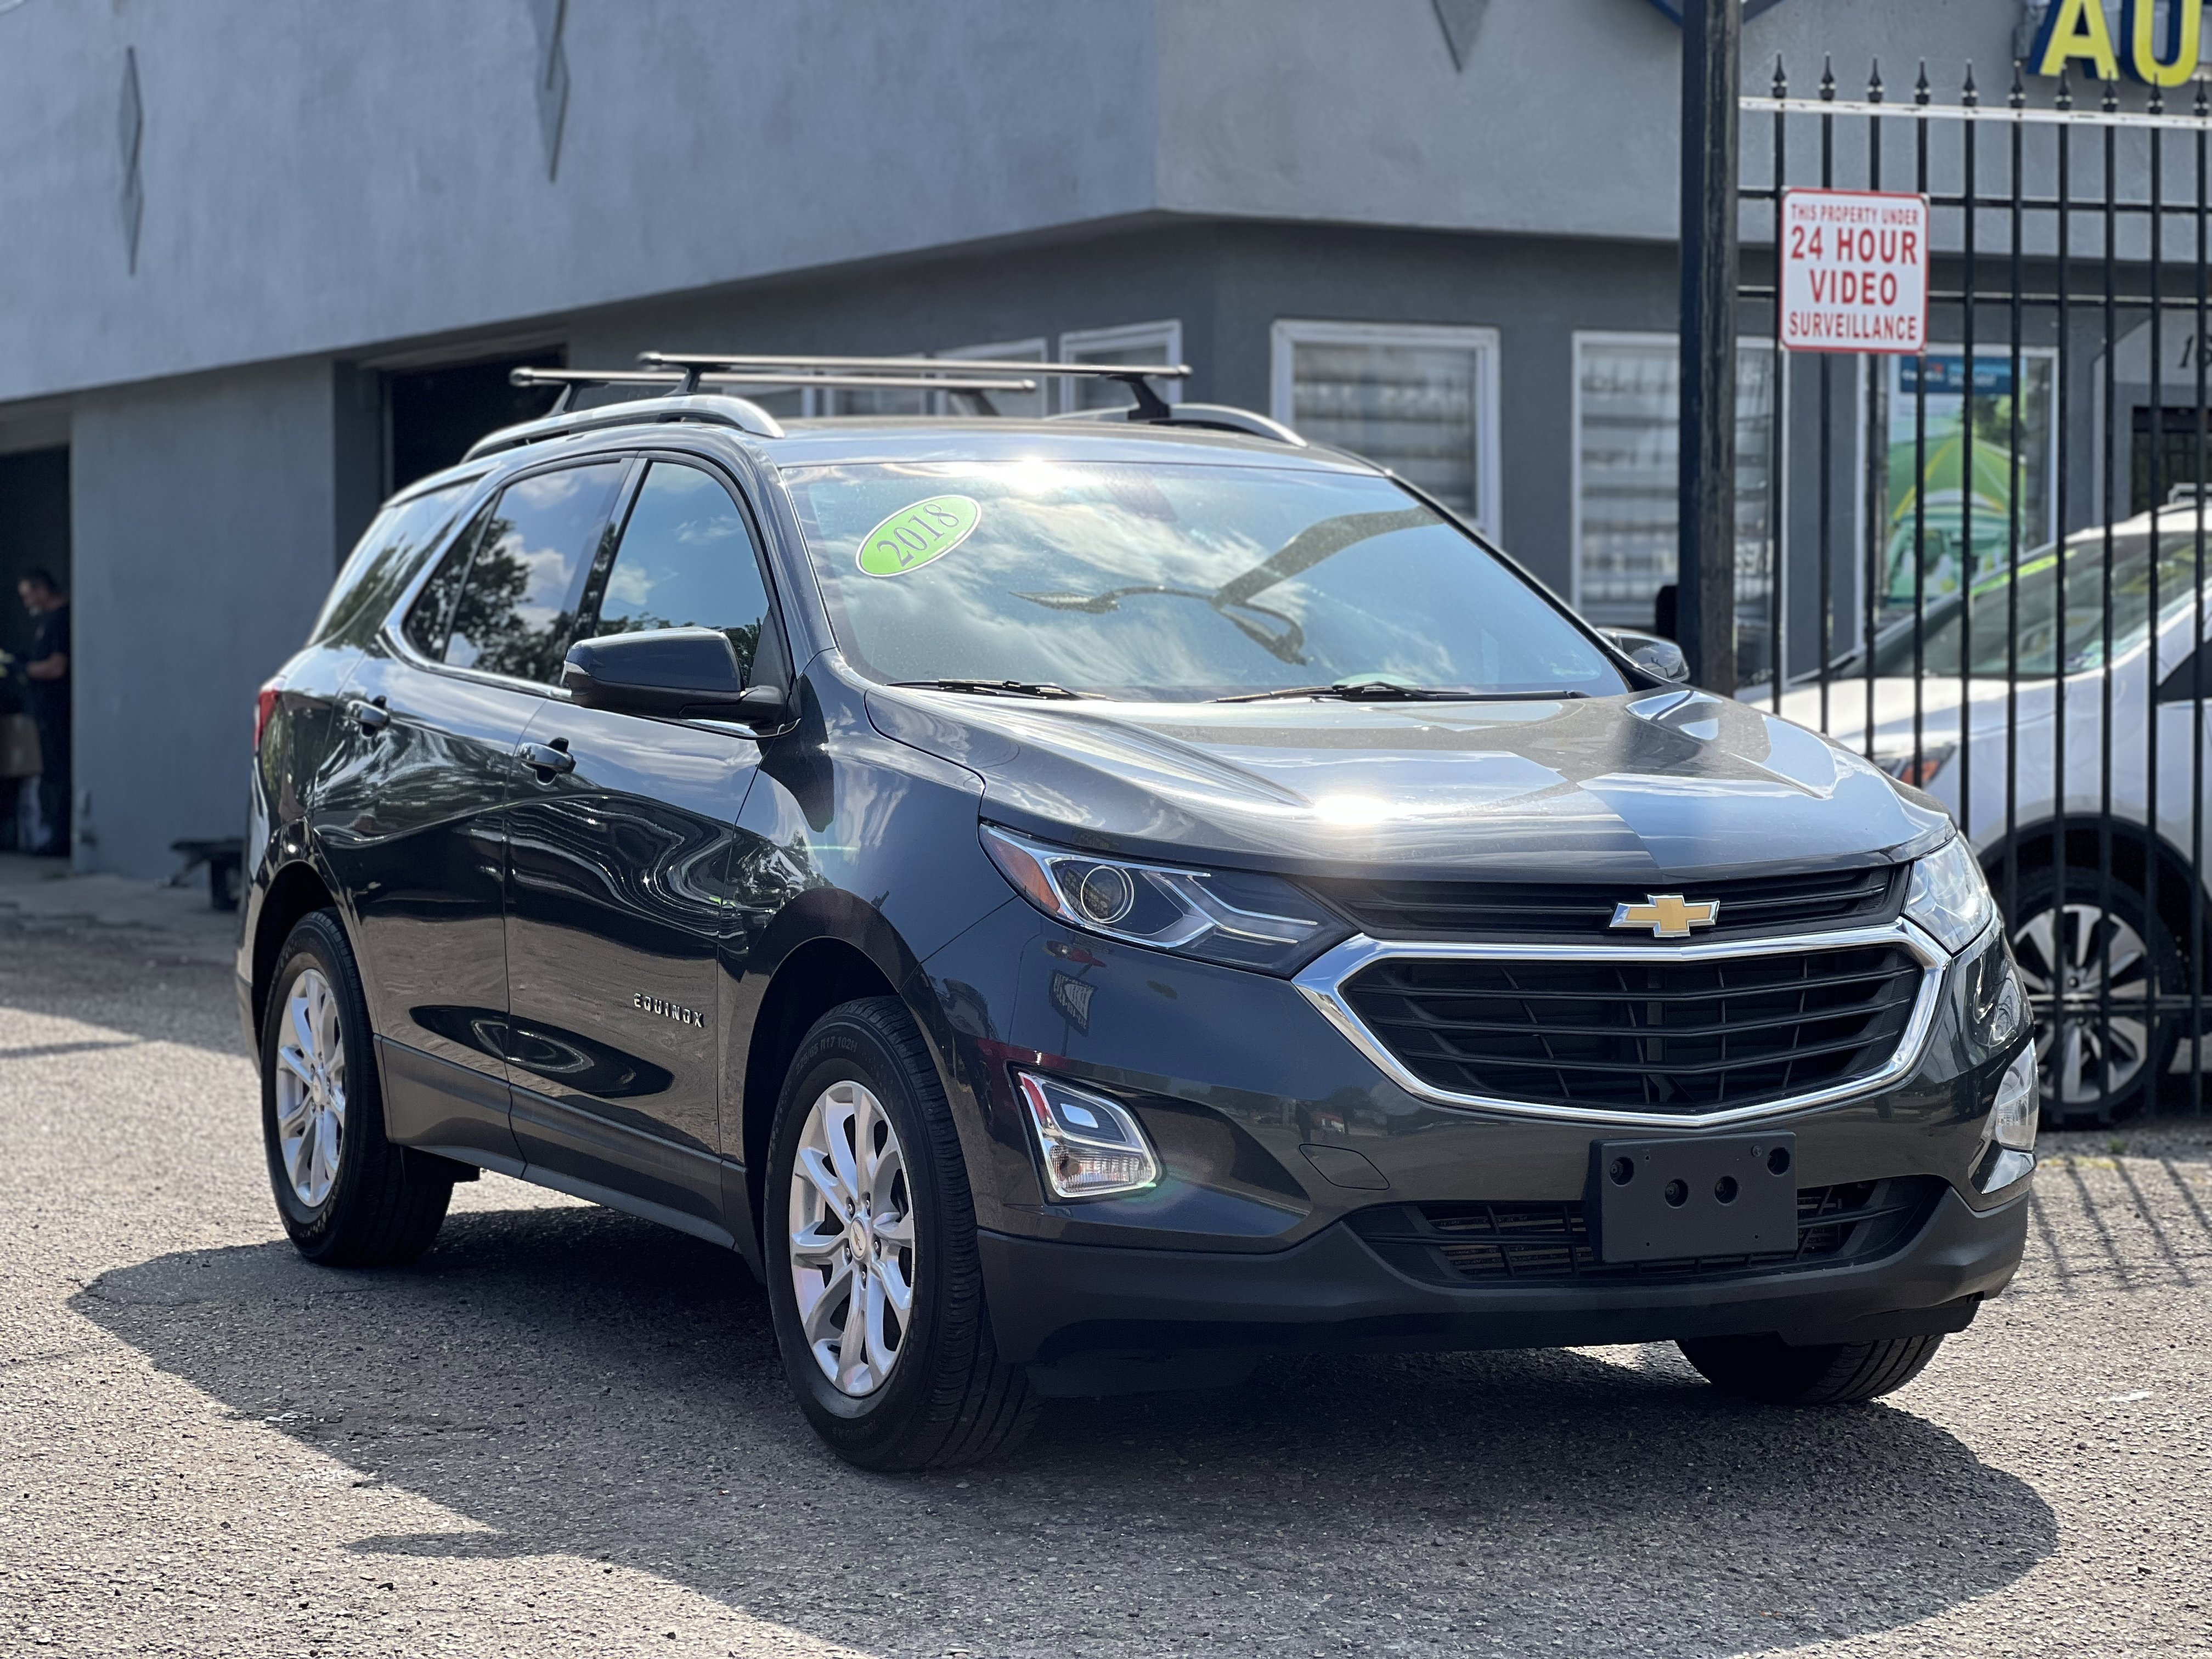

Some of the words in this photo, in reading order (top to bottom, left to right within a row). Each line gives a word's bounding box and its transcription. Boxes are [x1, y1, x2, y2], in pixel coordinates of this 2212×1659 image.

[2039, 0, 2202, 87] AU
[1791, 204, 1817, 221] THIS
[1820, 206, 1877, 223] PROPERTY
[1881, 208, 1919, 225] UNDER
[1791, 225, 1822, 260] 24
[1837, 228, 1917, 264] HOUR
[1809, 269, 1898, 306] VIDEO
[1789, 312, 1916, 340] SURVEILLANCE
[877, 503, 959, 567] 2018
[634, 992, 704, 1028] EQUINOX
